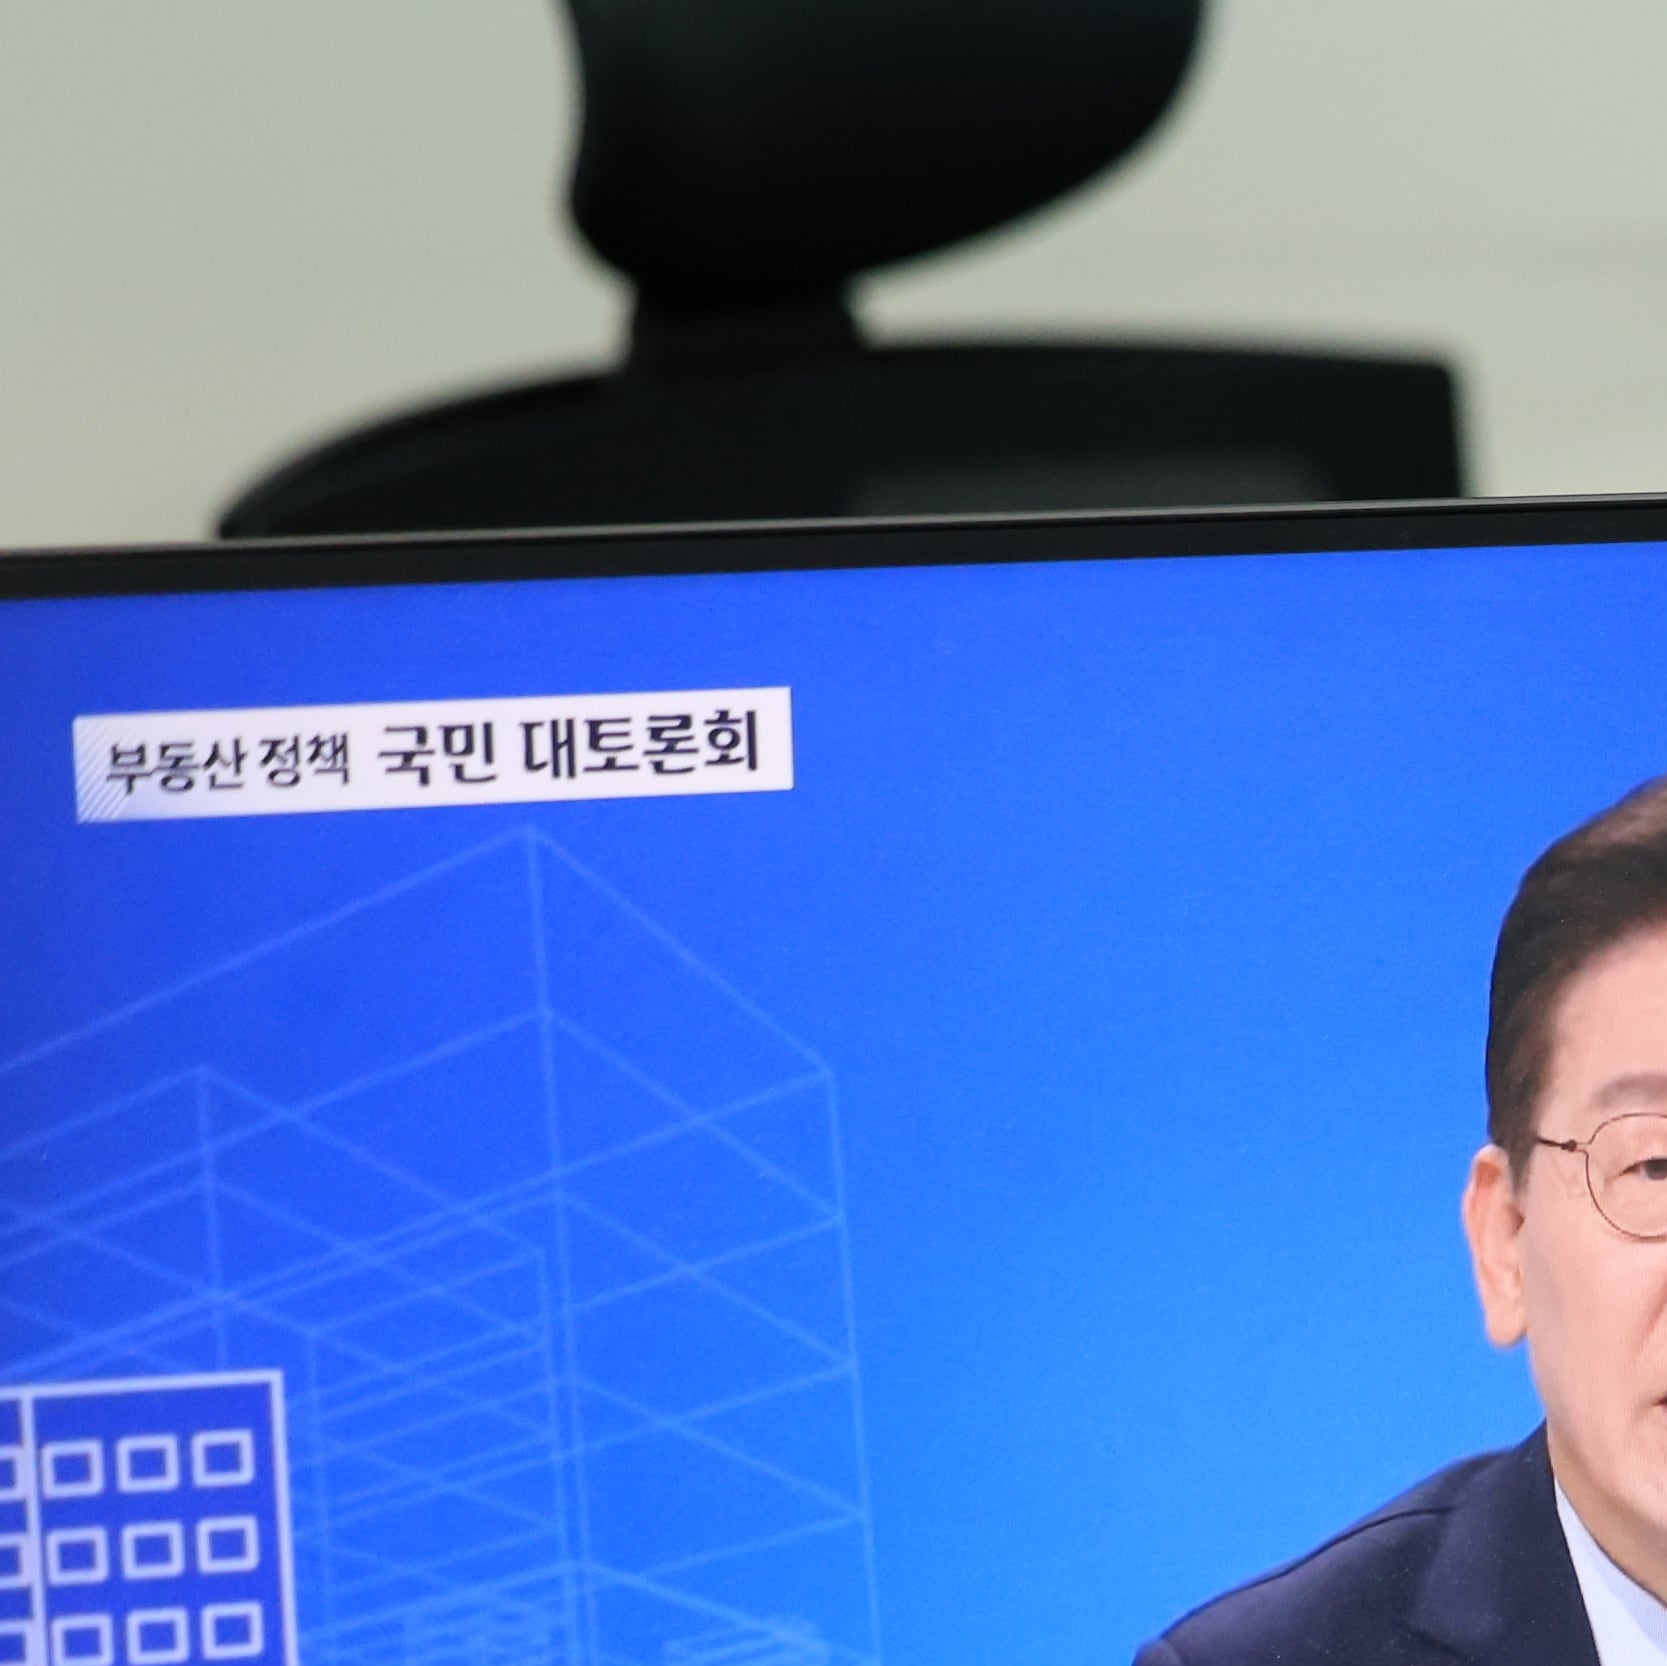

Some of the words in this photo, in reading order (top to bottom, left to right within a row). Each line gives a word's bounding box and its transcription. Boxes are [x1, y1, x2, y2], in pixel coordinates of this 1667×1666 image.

[105, 737, 249, 795] 부동산
[258, 730, 351, 788] 정책
[376, 722, 498, 786] 국민
[520, 708, 760, 781] 대토론회
